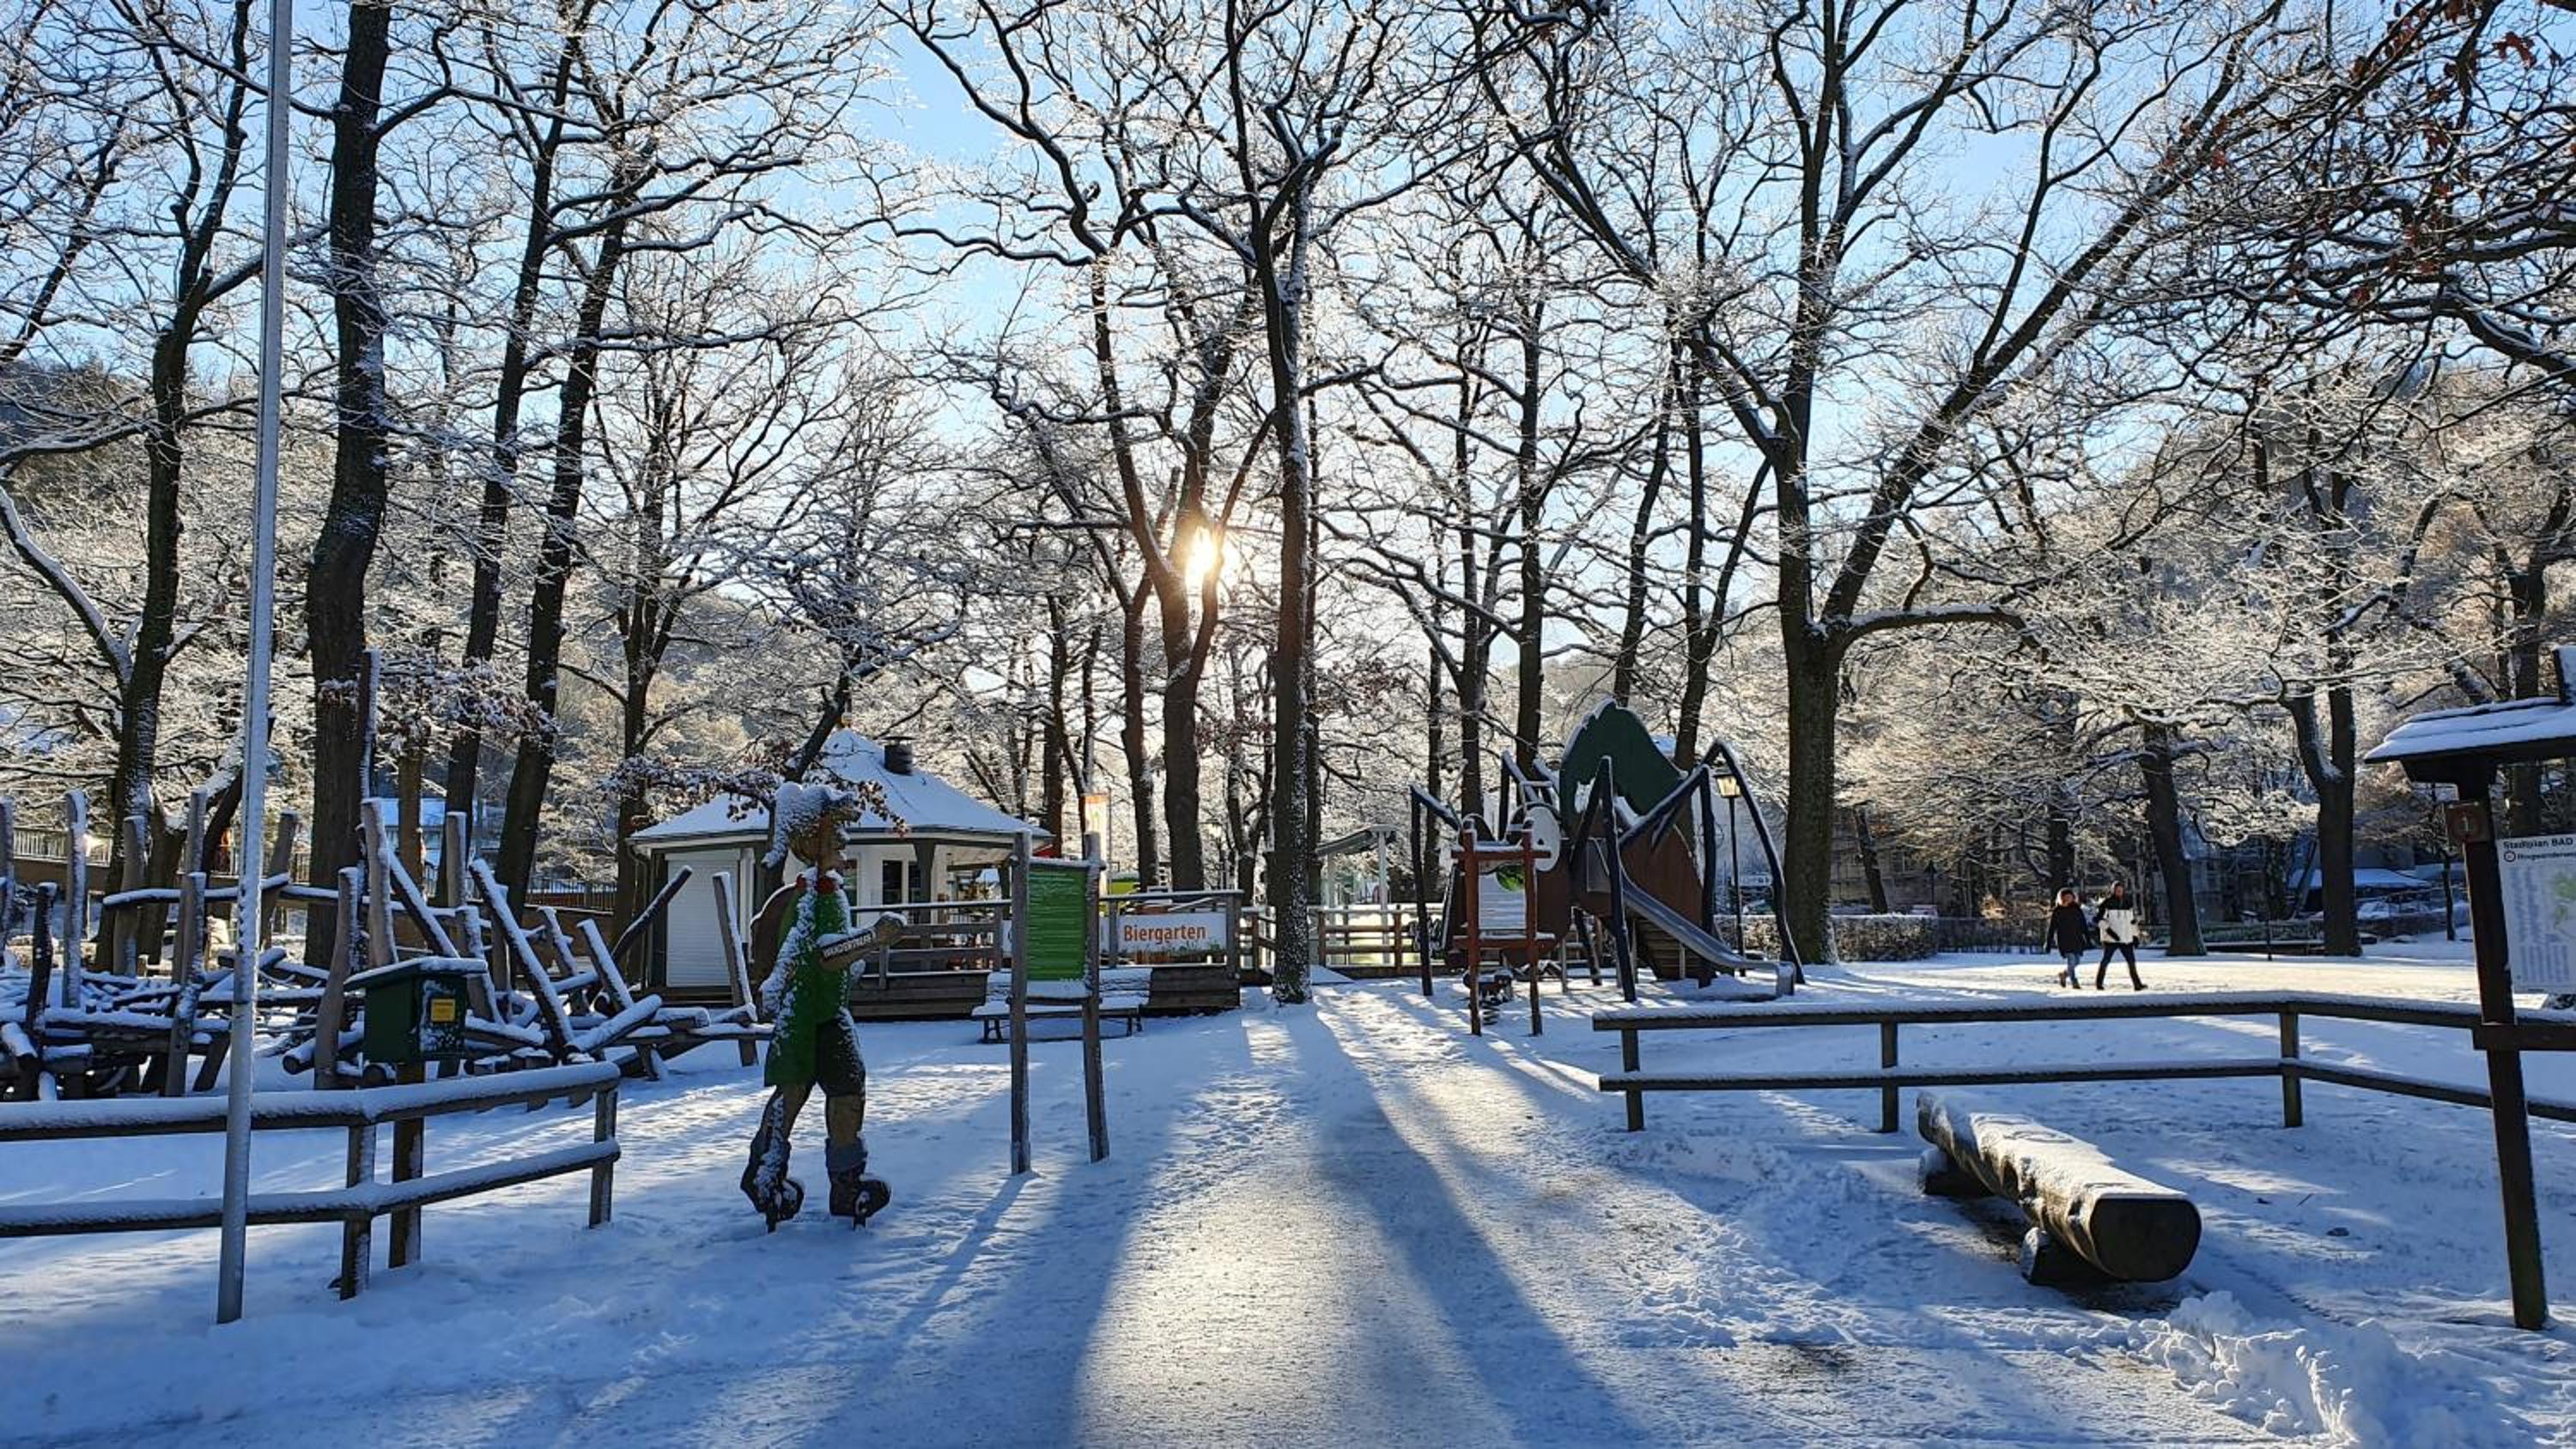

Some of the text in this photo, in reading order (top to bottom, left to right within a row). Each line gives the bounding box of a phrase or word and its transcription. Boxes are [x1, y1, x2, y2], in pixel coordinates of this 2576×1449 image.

[2503, 837, 2573, 849] Stadtplan BAD
[1124, 925, 1206, 945] Biergarten
